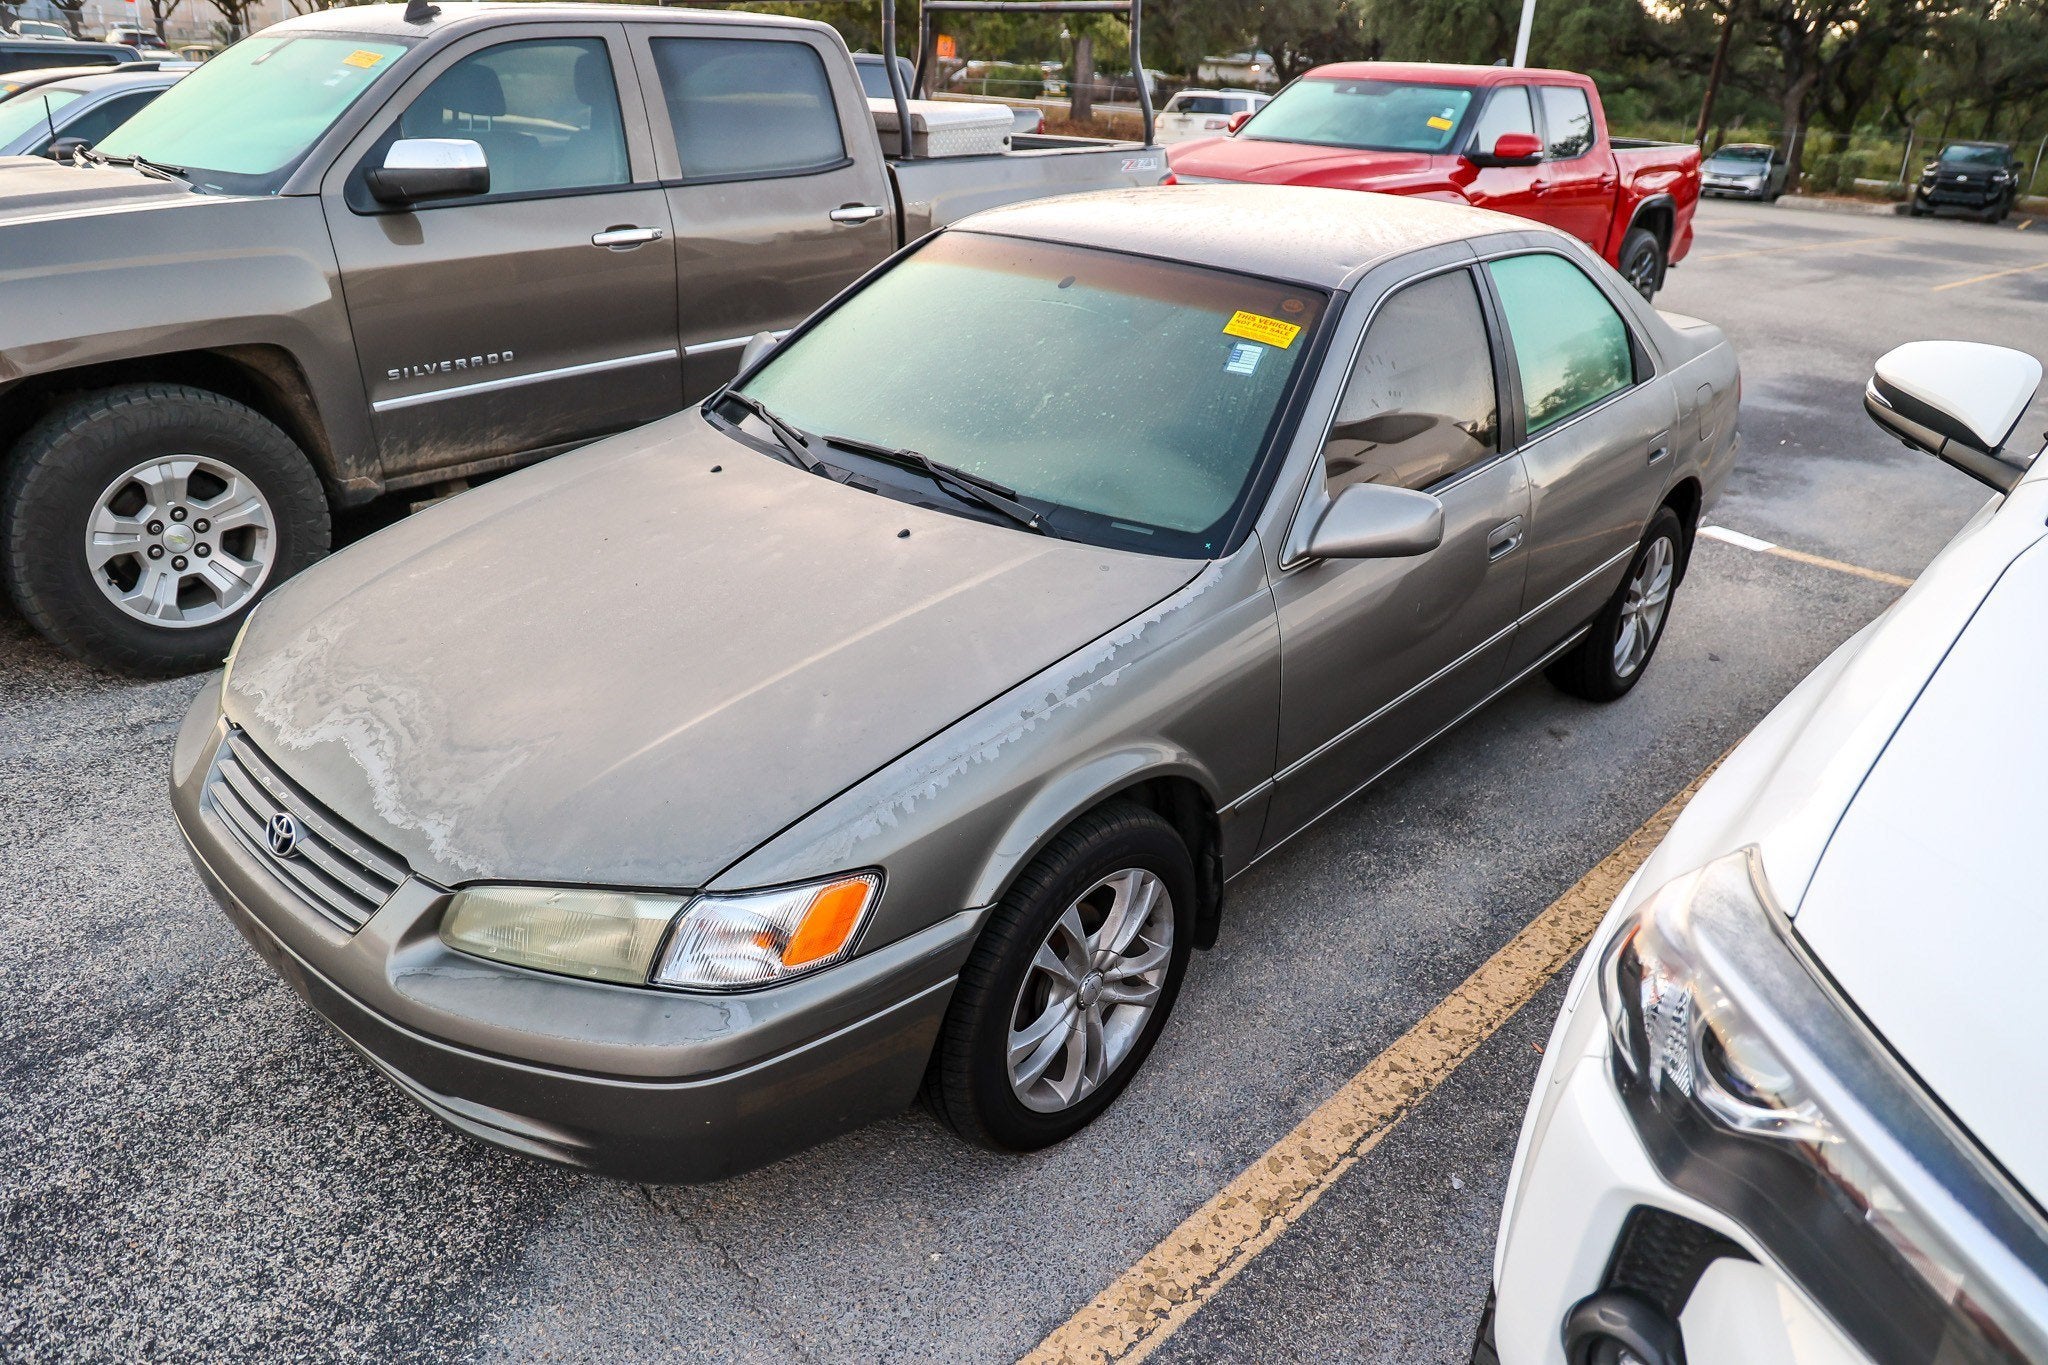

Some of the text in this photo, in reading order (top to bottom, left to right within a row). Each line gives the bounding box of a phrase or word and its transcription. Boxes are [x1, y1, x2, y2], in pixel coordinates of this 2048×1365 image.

[1236, 313, 1296, 332] THIS VEHICLE
[1252, 323, 1269, 331] FOR
[1269, 328, 1290, 336] SALE
[387, 350, 514, 380] SILVERADO
